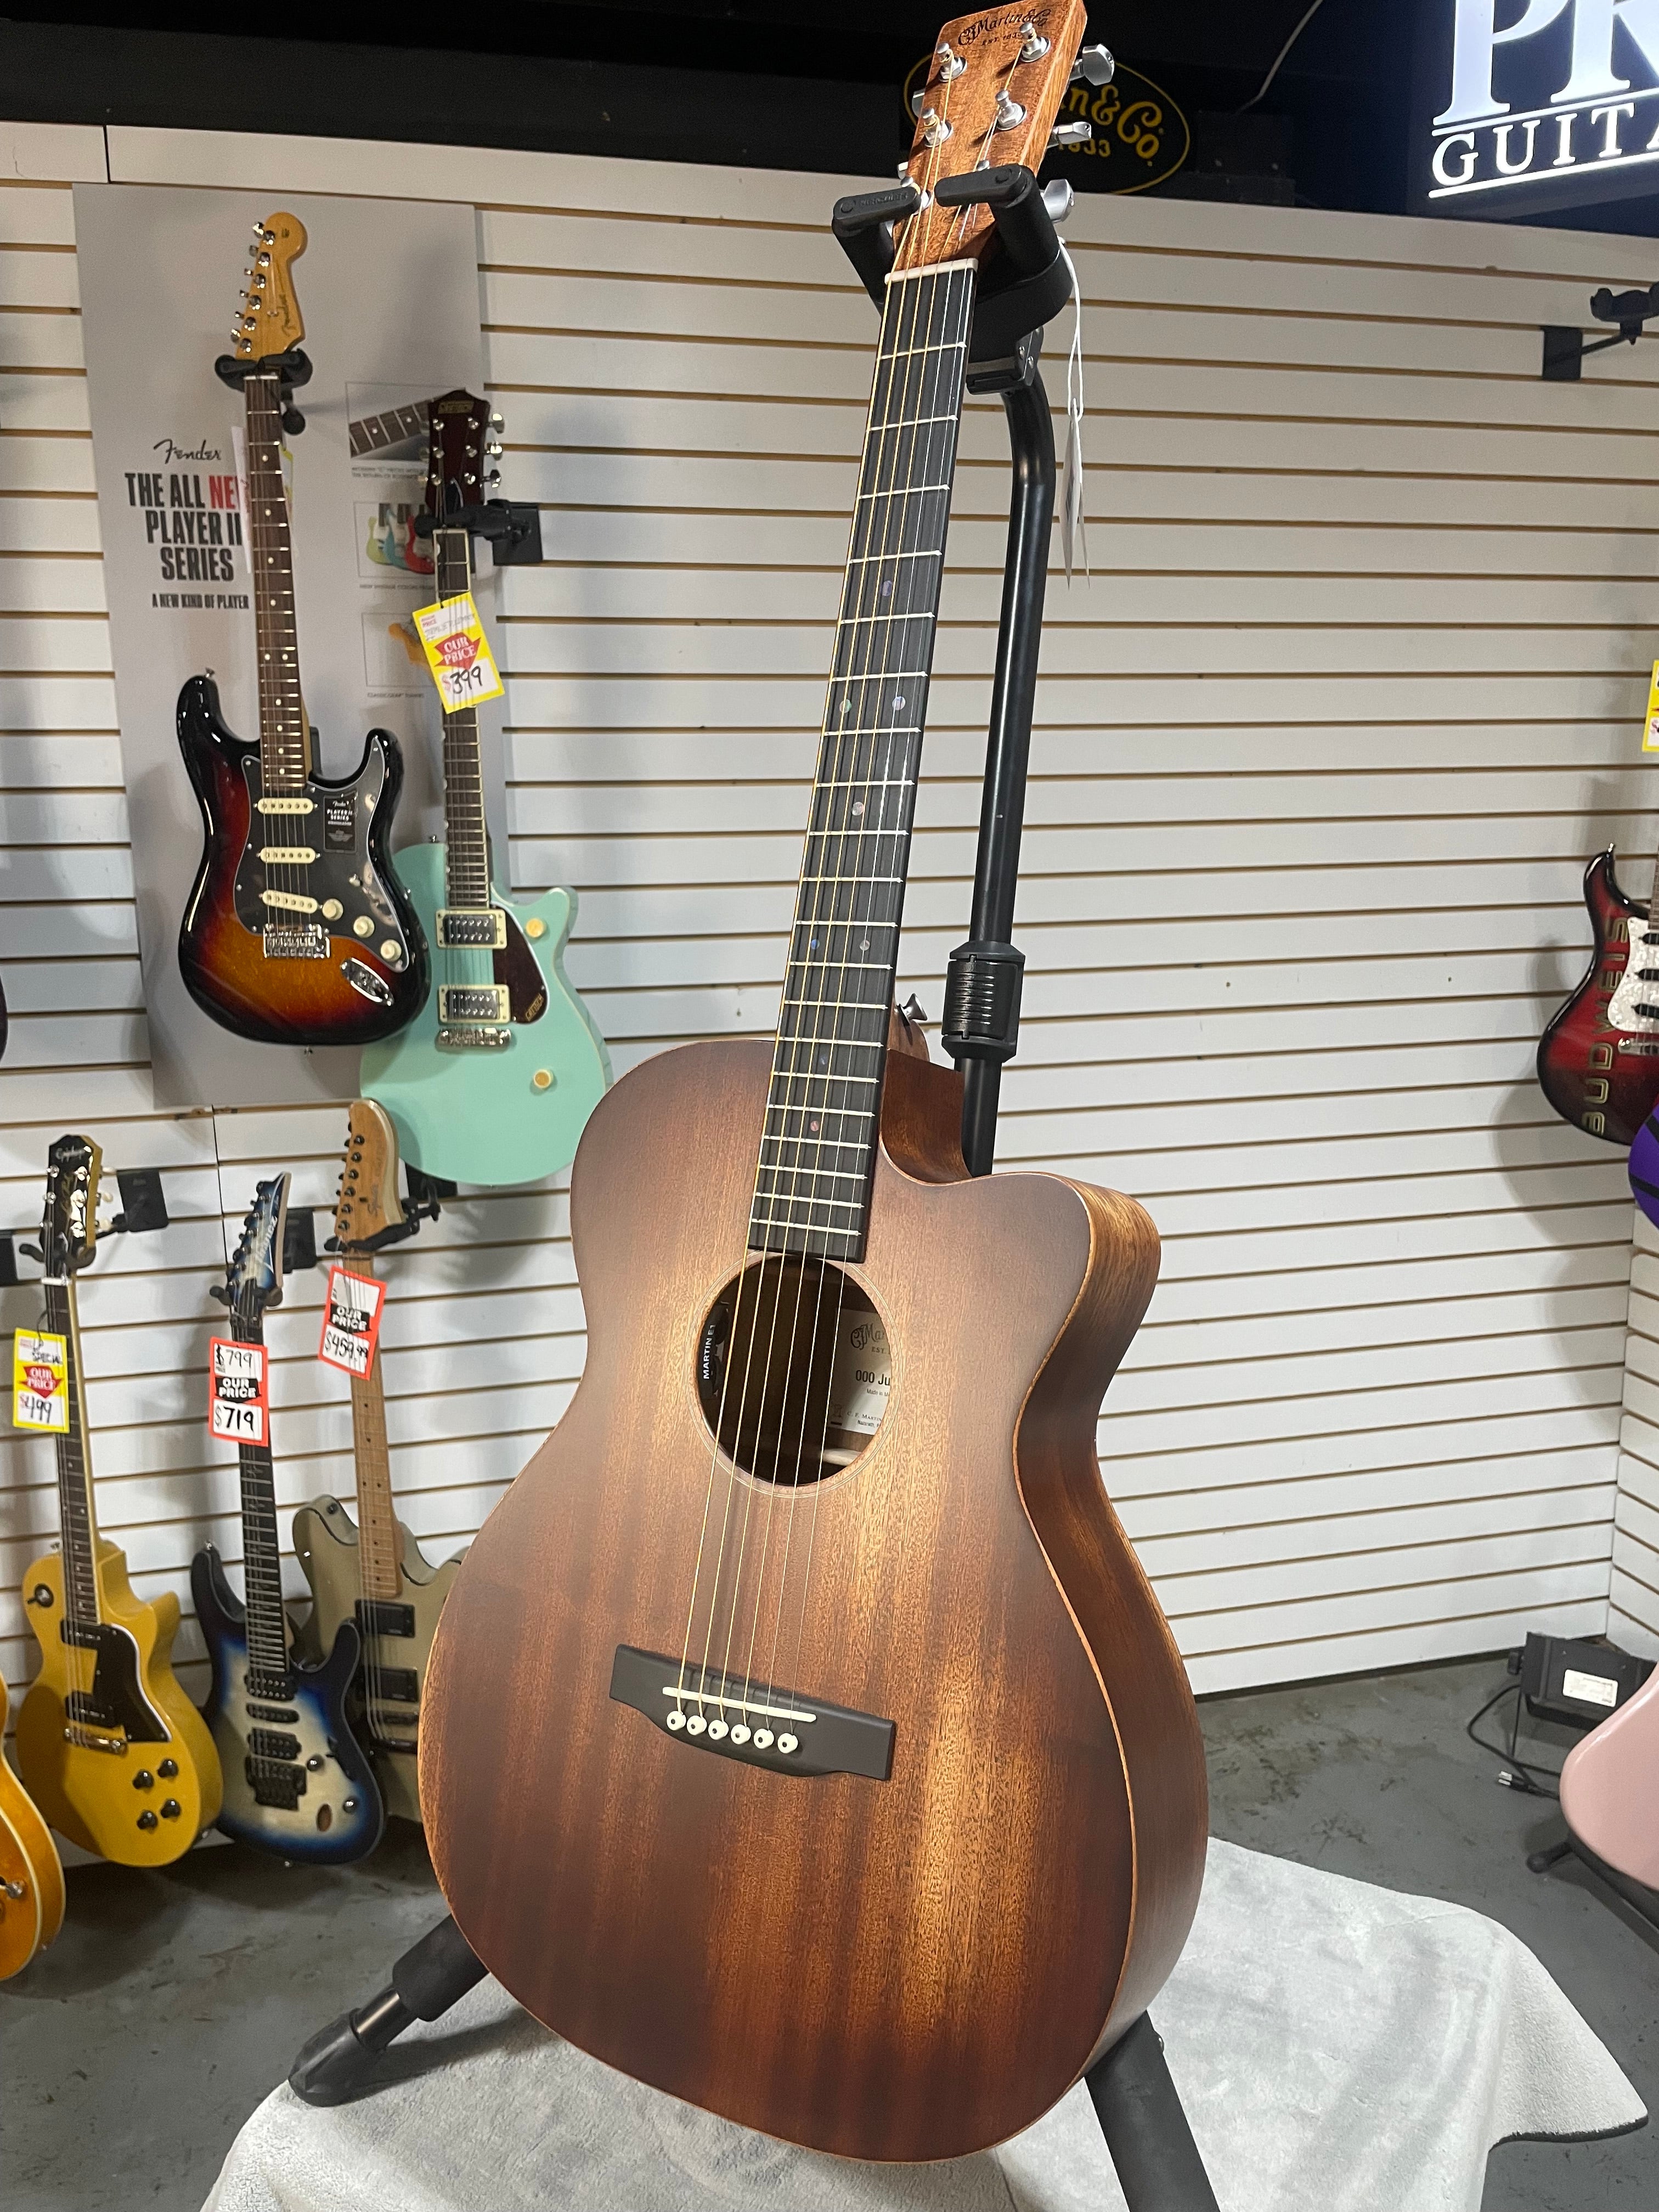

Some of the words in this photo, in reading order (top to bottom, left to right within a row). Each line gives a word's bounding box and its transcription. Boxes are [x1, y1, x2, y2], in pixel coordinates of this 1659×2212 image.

[153, 438, 221, 464] Fender
[125, 473, 165, 507] THE
[170, 474, 205, 508] ALL
[145, 510, 223, 545] PLAYER
[226, 512, 242, 546] II
[160, 546, 235, 582] SERIES
[152, 593, 159, 608] A
[160, 594, 179, 608] NEW
[181, 594, 203, 608] KIND
[204, 595, 215, 609] OF
[217, 595, 249, 609] PLAYER
[443, 636, 469, 653] OUR
[444, 645, 476, 665] PRICE
[336, 1305, 362, 1321] OUR
[332, 1313, 368, 1332] PRICE
[703, 1338, 712, 1379] MARTIN
[30, 1367, 52, 1379] OUR
[856, 1369, 875, 1384] 000
[27, 1376, 56, 1391] PRICE
[219, 1387, 257, 1398] PRICE
[222, 1378, 250, 1389] OUR
[215, 1405, 255, 1434] $719
